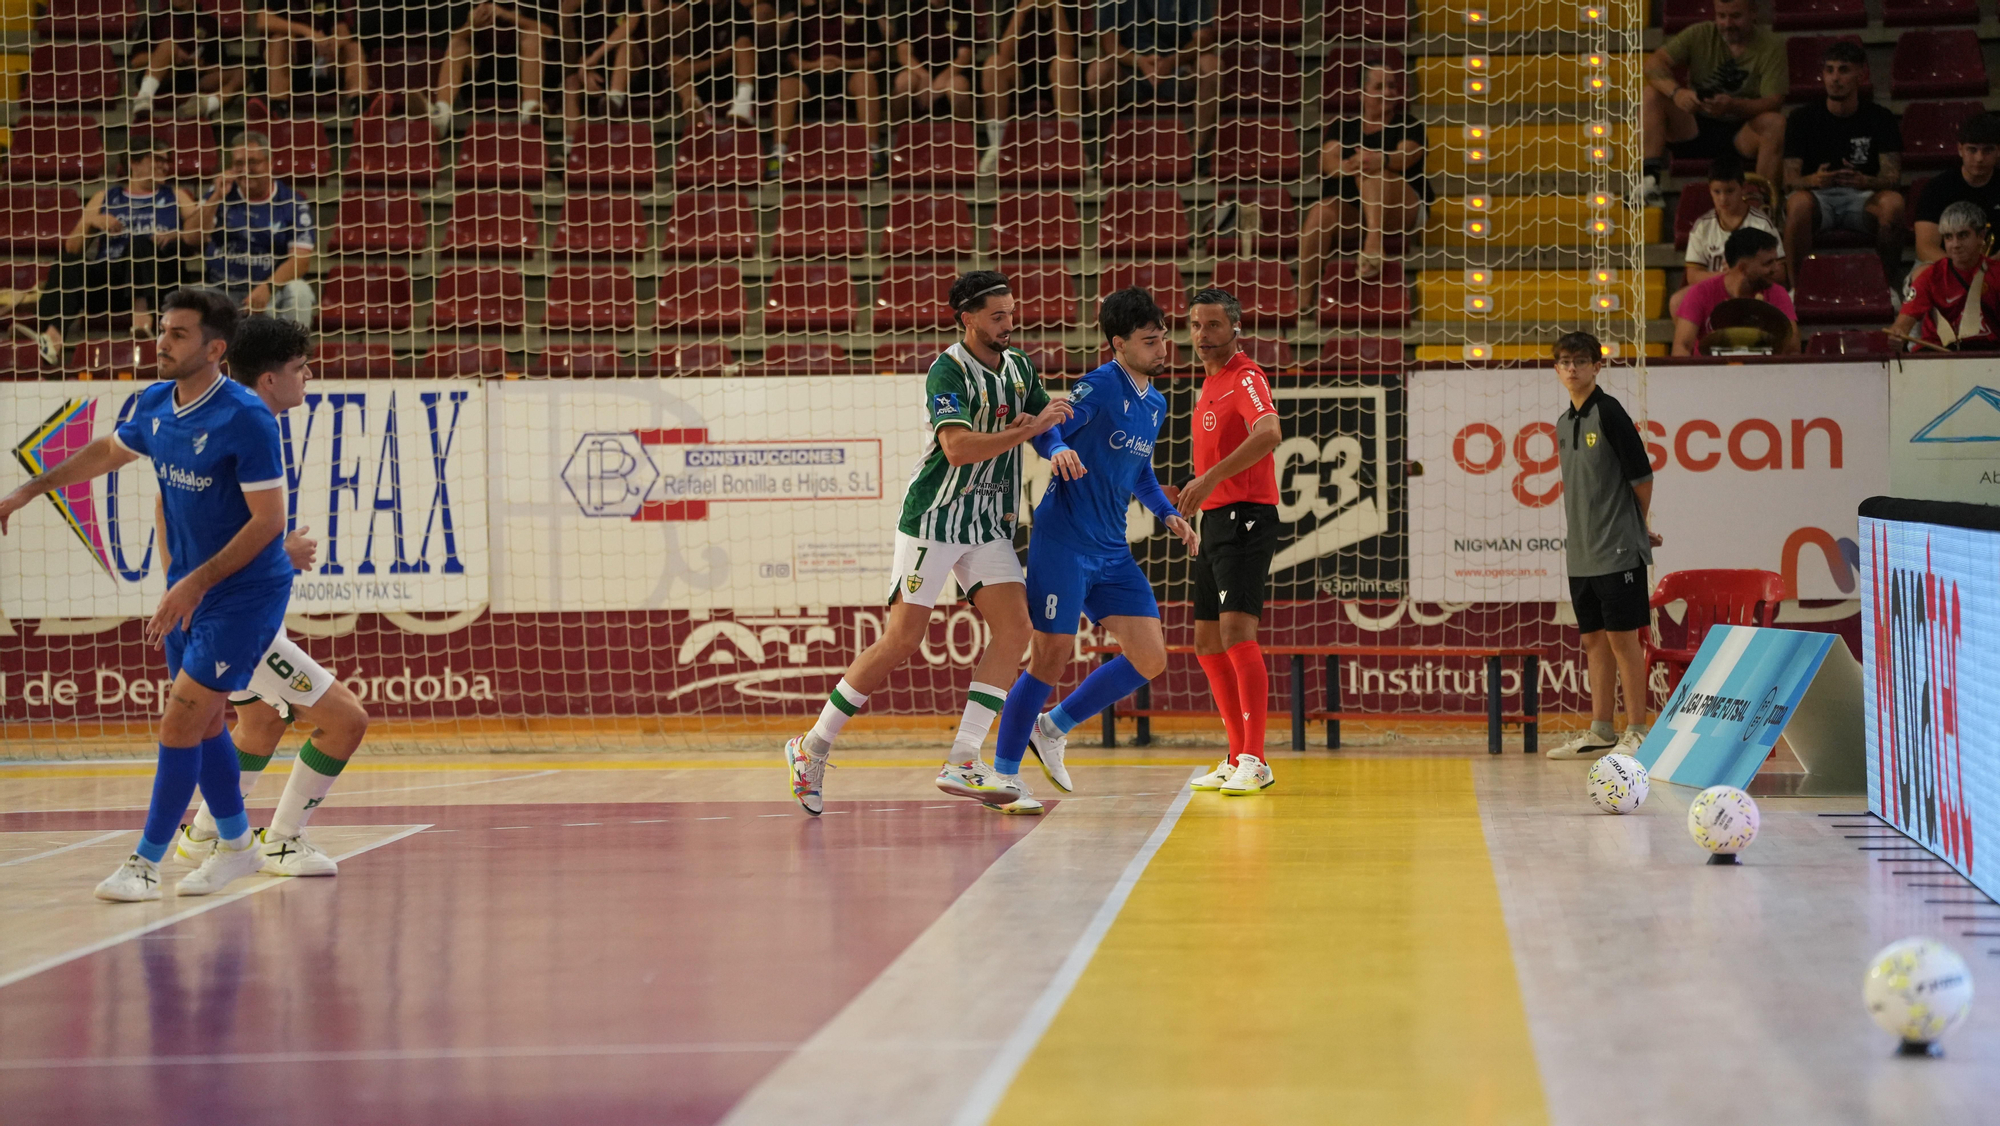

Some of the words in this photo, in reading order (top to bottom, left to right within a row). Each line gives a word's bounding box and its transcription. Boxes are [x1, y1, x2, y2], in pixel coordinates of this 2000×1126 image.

[687, 449, 843, 467] CONSTRUCCIONES
[1453, 417, 1843, 508] ogscan
[168, 463, 213, 492] hidalgo
[664, 474, 717, 494] Rafael
[722, 473, 776, 494] Bonilla
[781, 479, 792, 493] e
[914, 546, 928, 571] 7
[1454, 568, 1548, 579] www.ogescan.es
[366, 581, 389, 600] FAX
[1045, 593, 1058, 620] 8
[266, 651, 295, 680] 6
[1348, 660, 1521, 695] Instituo
[23, 670, 79, 706] de
[330, 666, 496, 702] órdoba
[1680, 692, 1703, 715] LIGA
[1717, 697, 1751, 722] FUTSAL
